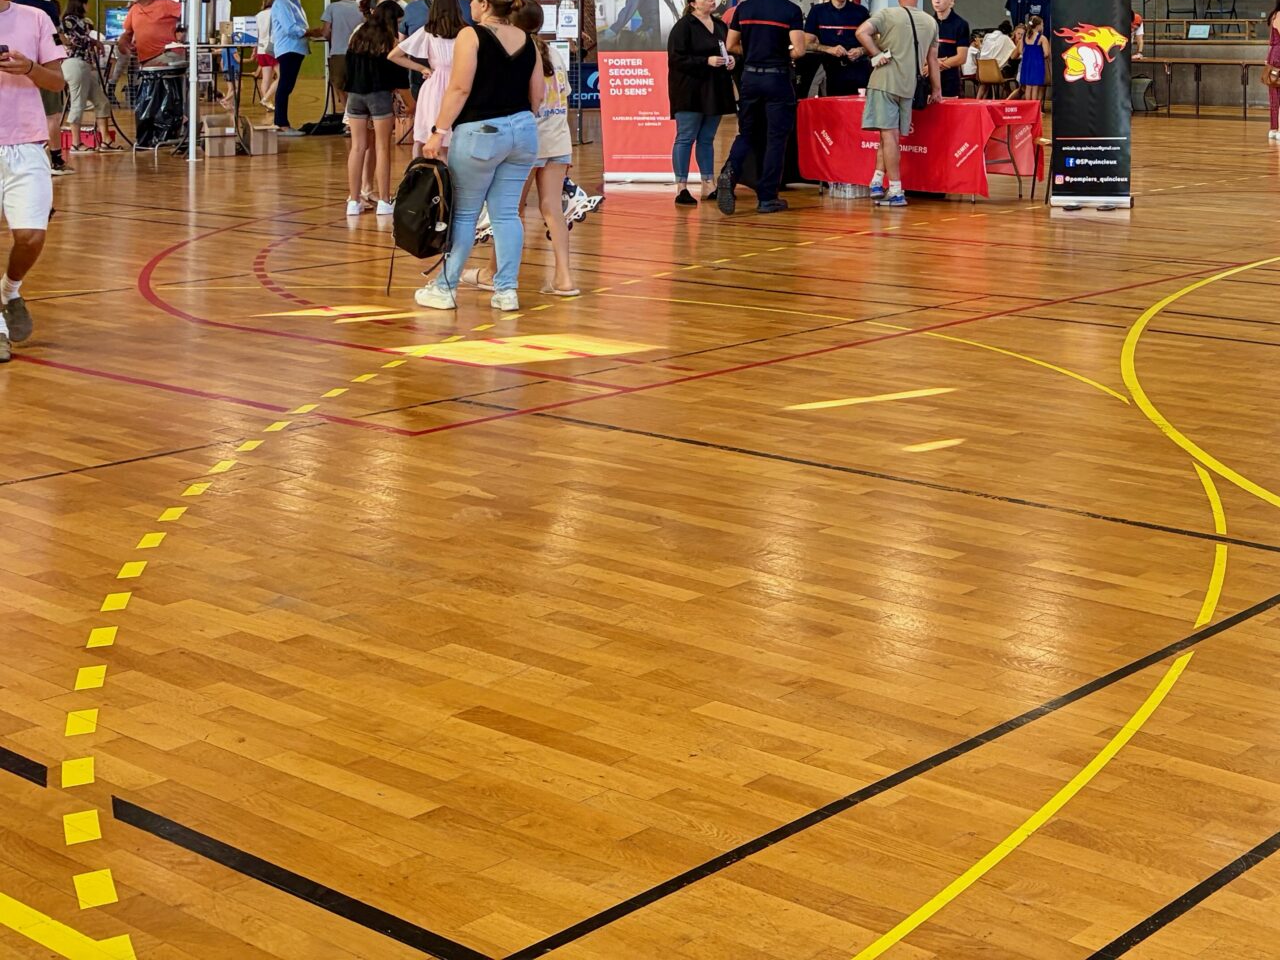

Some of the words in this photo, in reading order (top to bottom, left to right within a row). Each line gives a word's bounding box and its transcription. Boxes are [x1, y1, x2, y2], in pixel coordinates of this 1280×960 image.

[608, 68, 651, 77] SECOURS,
[609, 78, 622, 88] ÇA
[623, 78, 655, 86] DONNE
[609, 88, 623, 96] DU
[861, 141, 880, 150] SAPE
[899, 144, 928, 154] OMPIERS
[1075, 158, 1118, 167] @SPquincieux
[1065, 175, 1128, 184] @pompiers_quincieux
